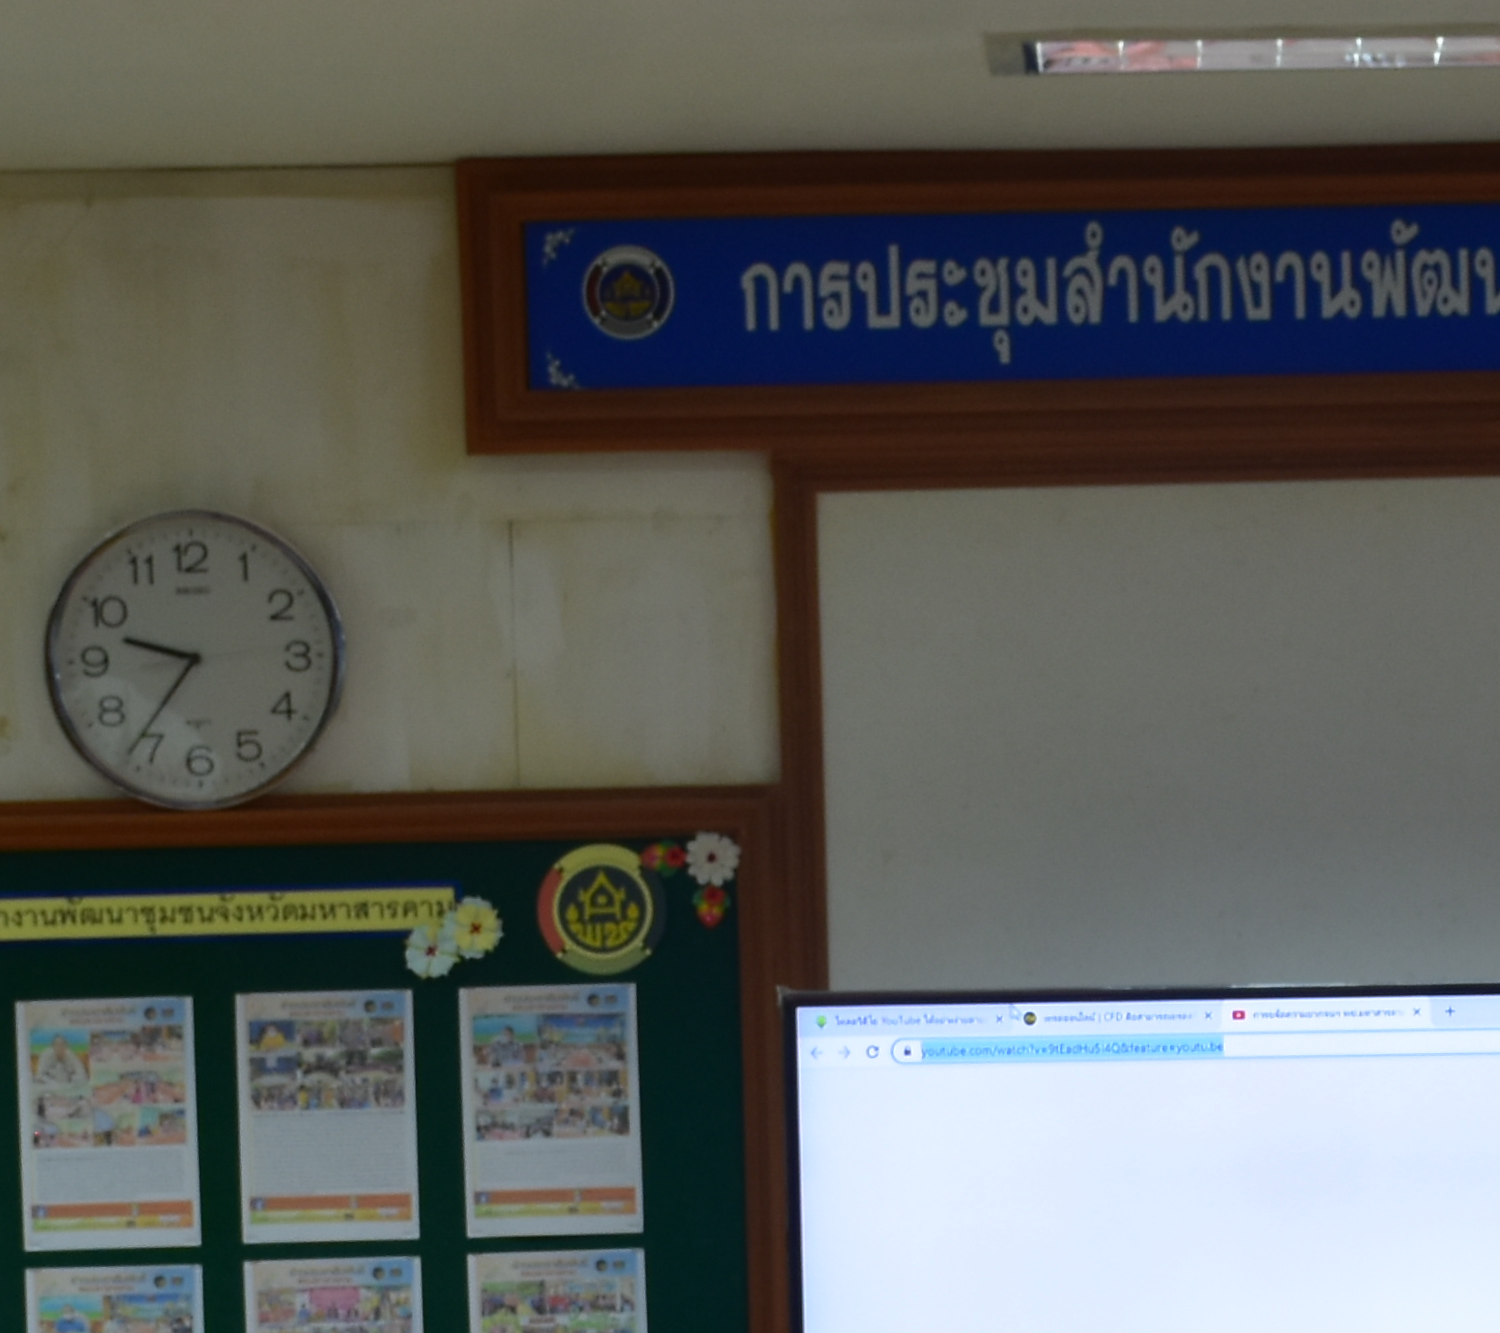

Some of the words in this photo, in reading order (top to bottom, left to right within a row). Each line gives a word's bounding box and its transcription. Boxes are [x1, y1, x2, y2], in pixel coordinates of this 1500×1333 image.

[129, 554, 155, 585] 11
[173, 541, 209, 573] 12
[239, 552, 250, 582] 1
[89, 596, 128, 628] 10
[268, 589, 295, 621] 2
[81, 646, 109, 678] 9
[284, 640, 312, 672] 3
[98, 696, 126, 727] 8
[271, 691, 298, 721] 4
[142, 733, 165, 763] 7
[186, 745, 215, 777] 6
[236, 730, 263, 762] 5
